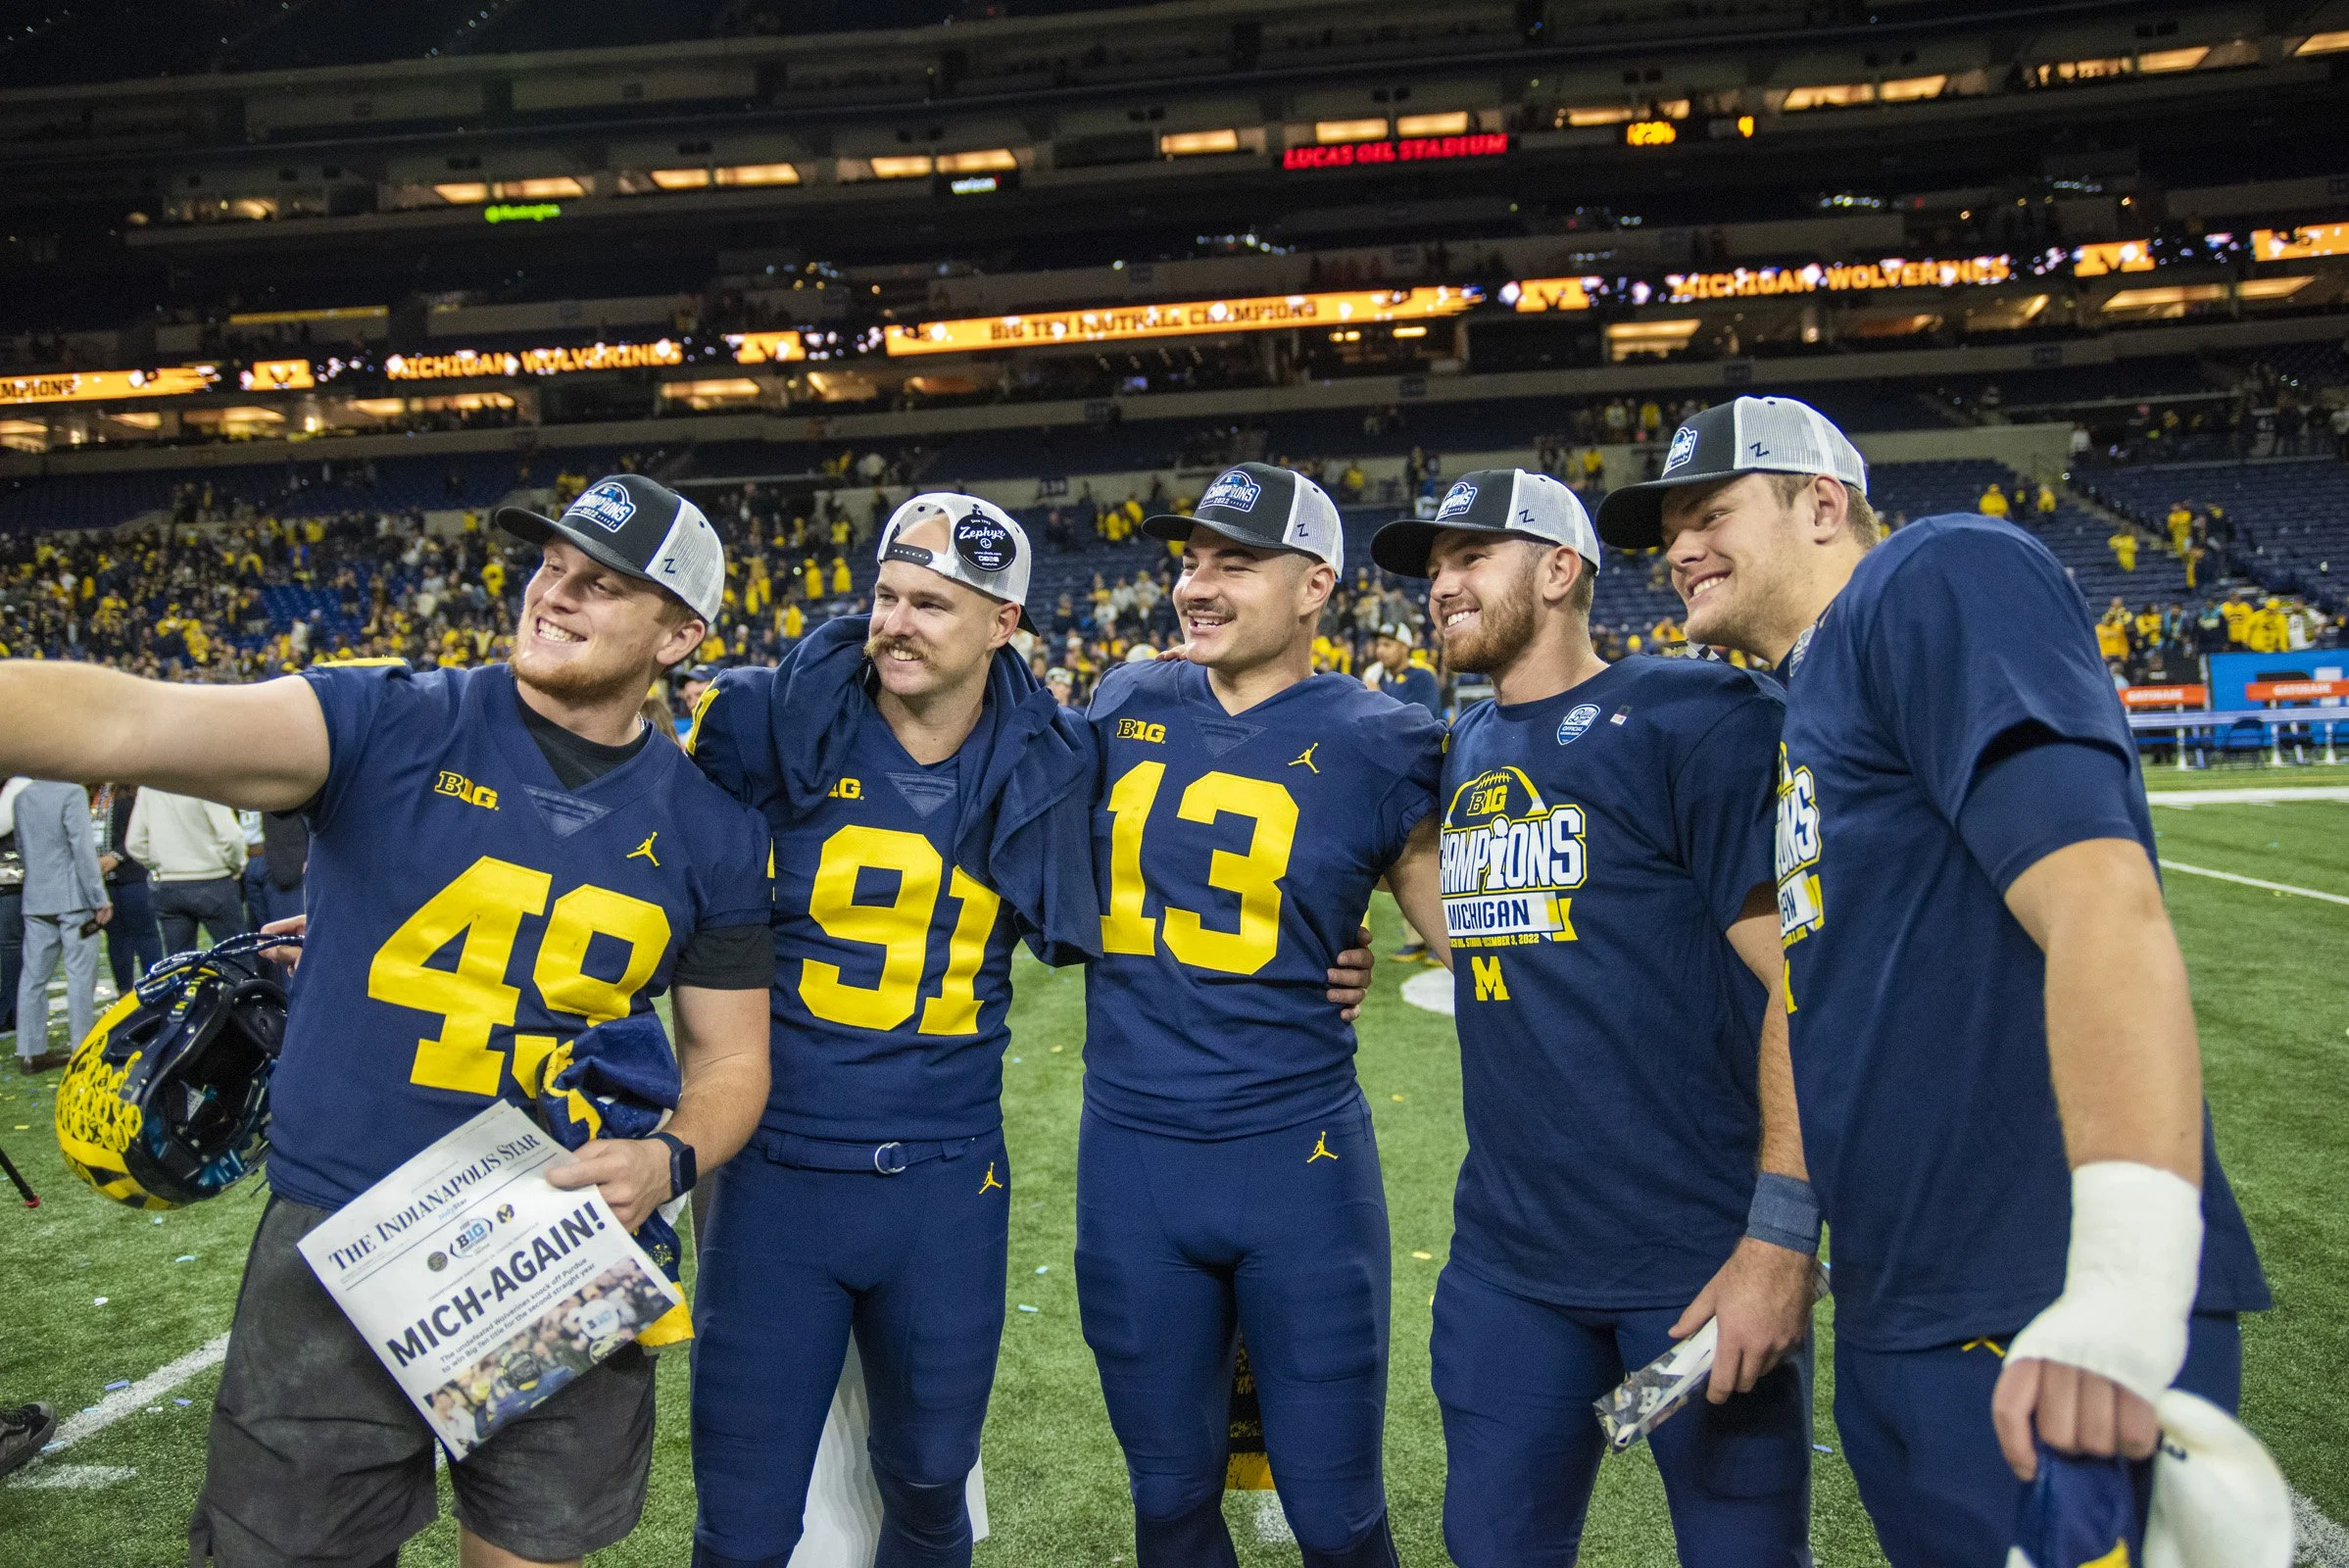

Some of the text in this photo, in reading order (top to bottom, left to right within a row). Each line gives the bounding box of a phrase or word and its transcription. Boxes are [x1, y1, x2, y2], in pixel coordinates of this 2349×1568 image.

[1283, 133, 1508, 170] LUCAS OIL STADIUM
[1672, 258, 2010, 298] MICHIGAN WOLVERINES
[387, 342, 683, 379] MICHIGAN WOLVERINES
[958, 526, 1005, 540] Zephyr
[1100, 760, 1299, 975] 13
[798, 824, 1001, 1035] 91
[1448, 899, 1531, 931] MICHIGAN
[1518, 933, 1540, 945] 2022
[1471, 956, 1510, 1001] M
[375, 1153, 502, 1243] INDIANAPOLIS
[497, 1133, 541, 1161] STAR
[386, 1200, 606, 1368] MICH-AGAIN!
[440, 1258, 587, 1363] The undefeated Wolverines knock off Purdue
[452, 1356, 465, 1367] win
[465, 1348, 478, 1359] Big
[477, 1337, 490, 1349] Ten
[490, 1328, 505, 1341] title
[505, 1319, 515, 1333] for
[514, 1311, 528, 1323] the
[528, 1293, 553, 1313] second
[553, 1273, 580, 1298] straight
[579, 1262, 596, 1278] year
